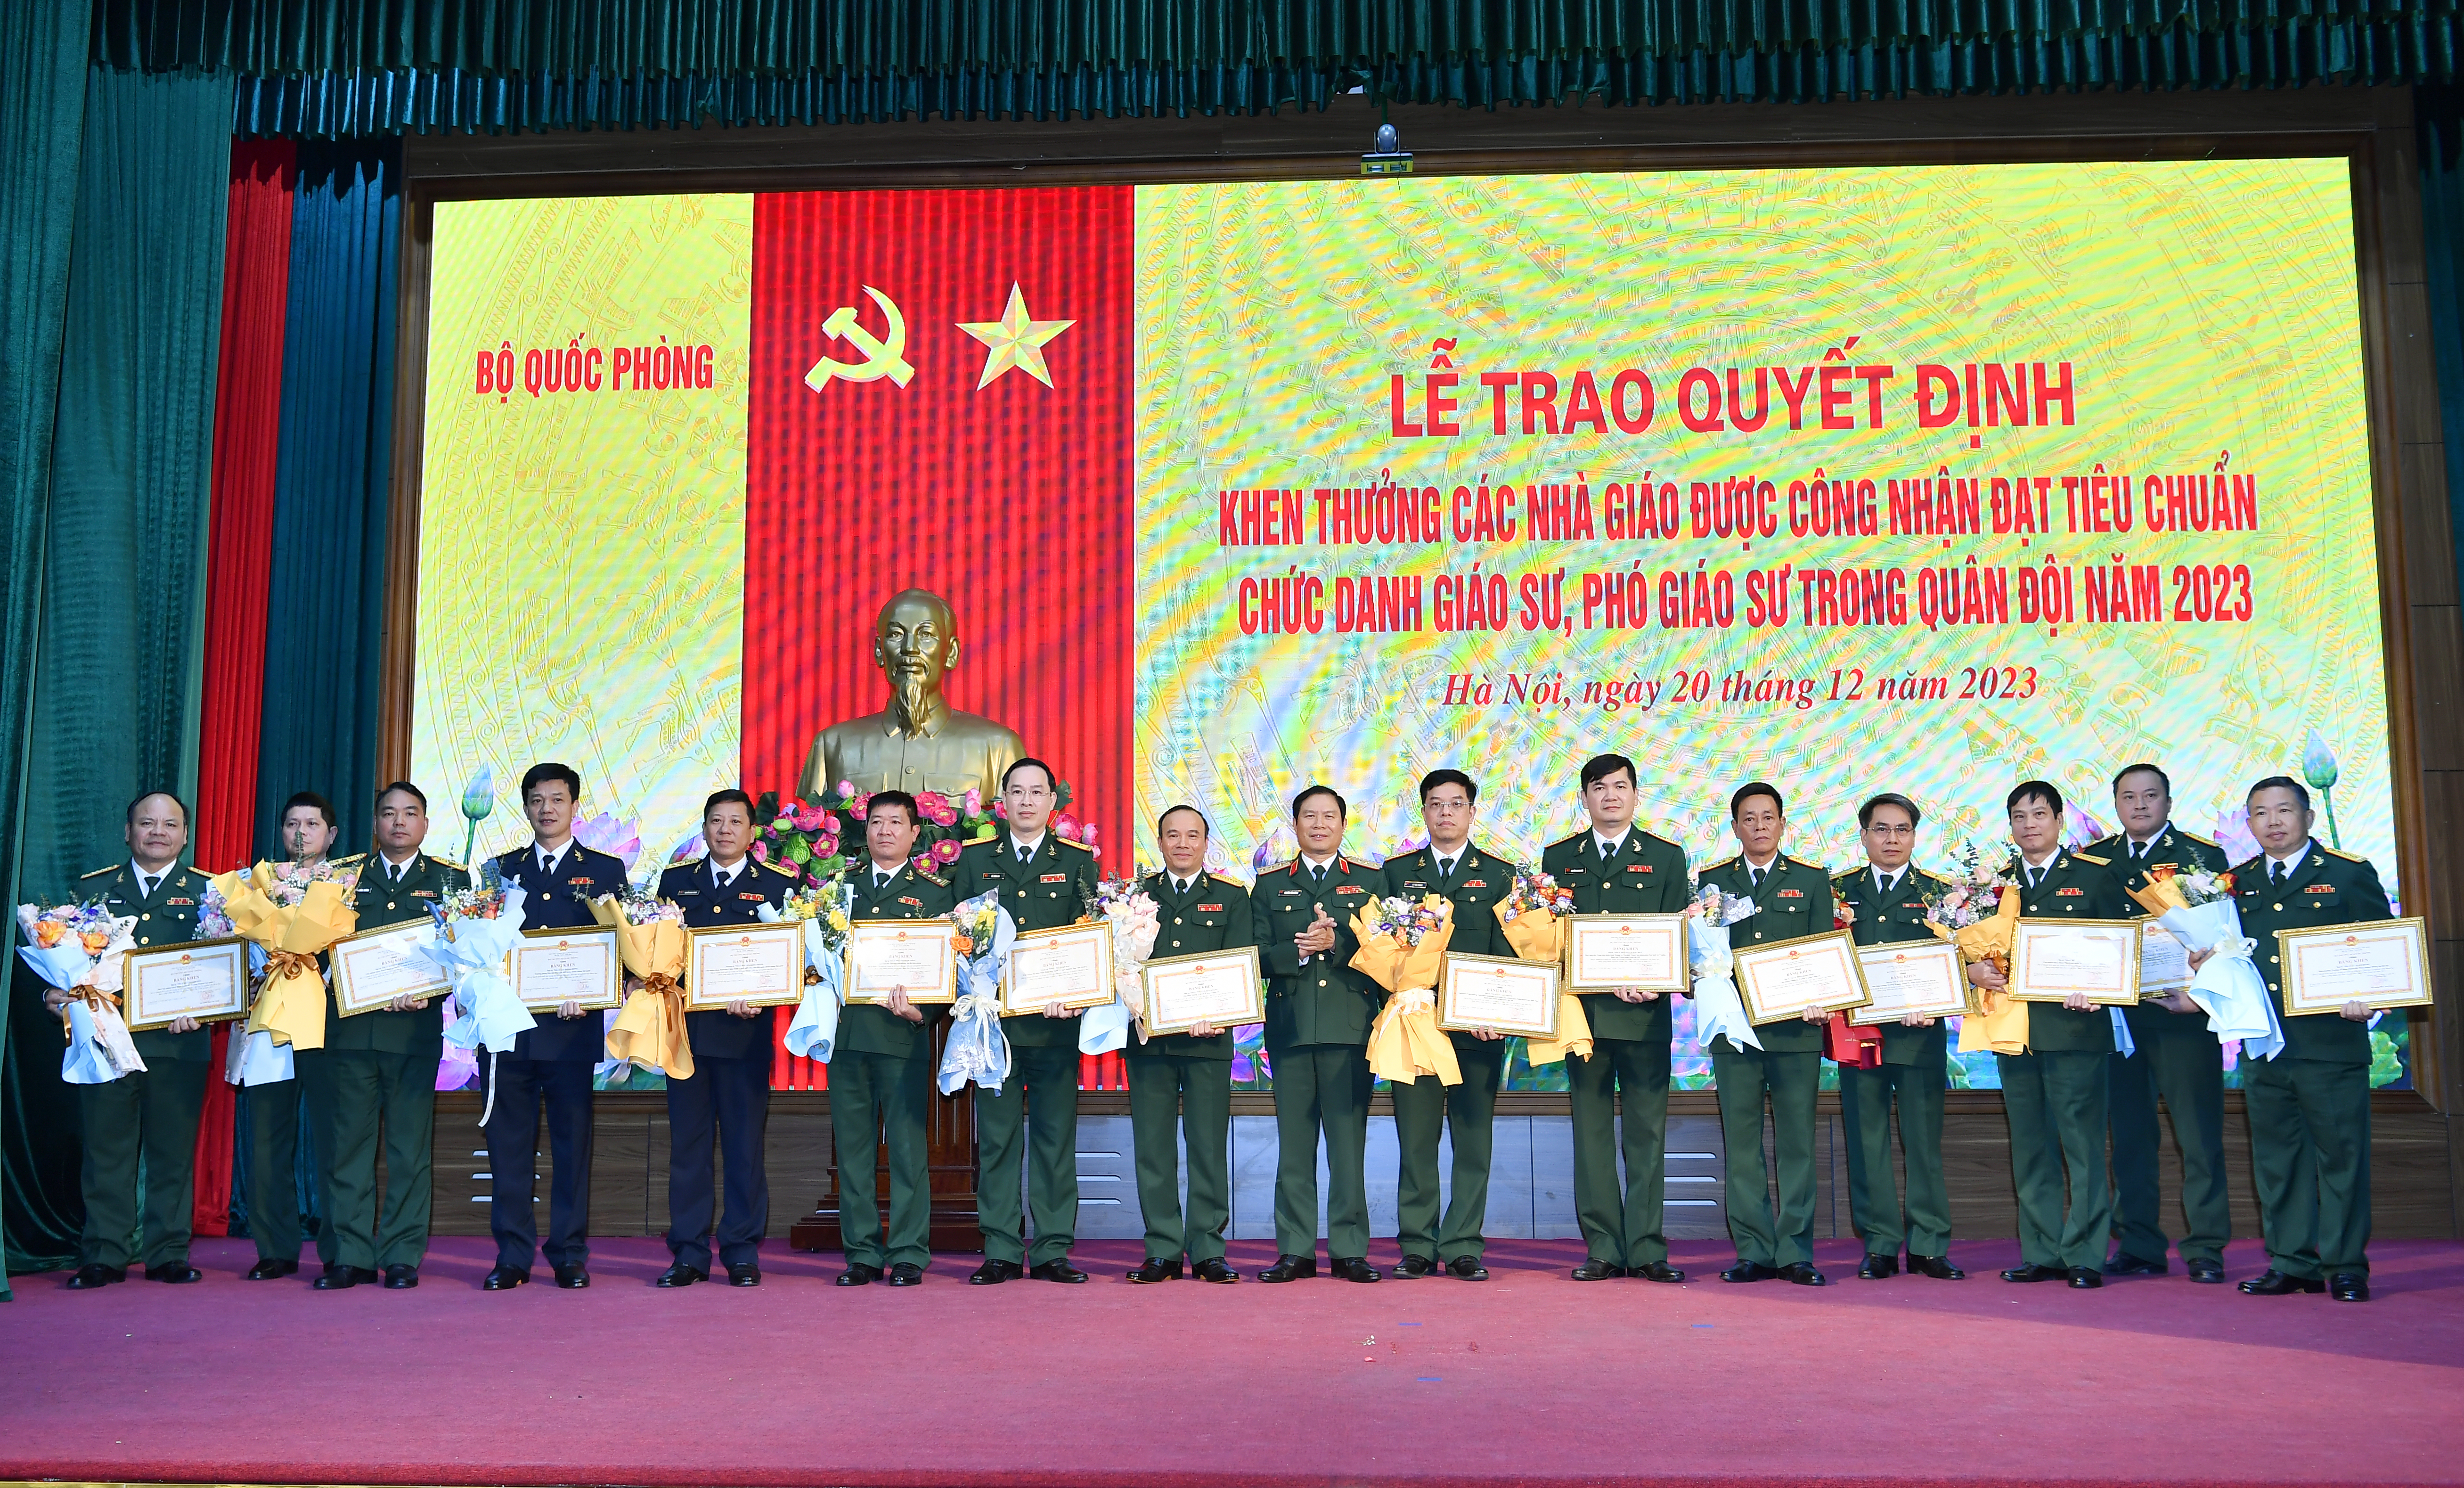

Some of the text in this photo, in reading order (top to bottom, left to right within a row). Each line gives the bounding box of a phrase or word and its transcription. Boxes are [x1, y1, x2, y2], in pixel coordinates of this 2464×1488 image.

[476, 333, 713, 404] BỘ QUỐC PHÒNG
[1391, 336, 2075, 449] LỄ TRAO QUYẾT ĐỊNH
[1219, 450, 2257, 551] KHEN THƯỞNG CÁC NHÀ GIÁO ĐƯỢC CÔNG NHẬN ĐẠT TIÊU CHUẨN
[1239, 553, 2252, 638] CHỨC DANH GIÁO SƯ, PHÓ GIÁO SƯ TRONG QUÂN ĐỘI NĂM 2023
[1442, 666, 2038, 713] Hà Nội, ngày 20 tháng 12 năm 2023
